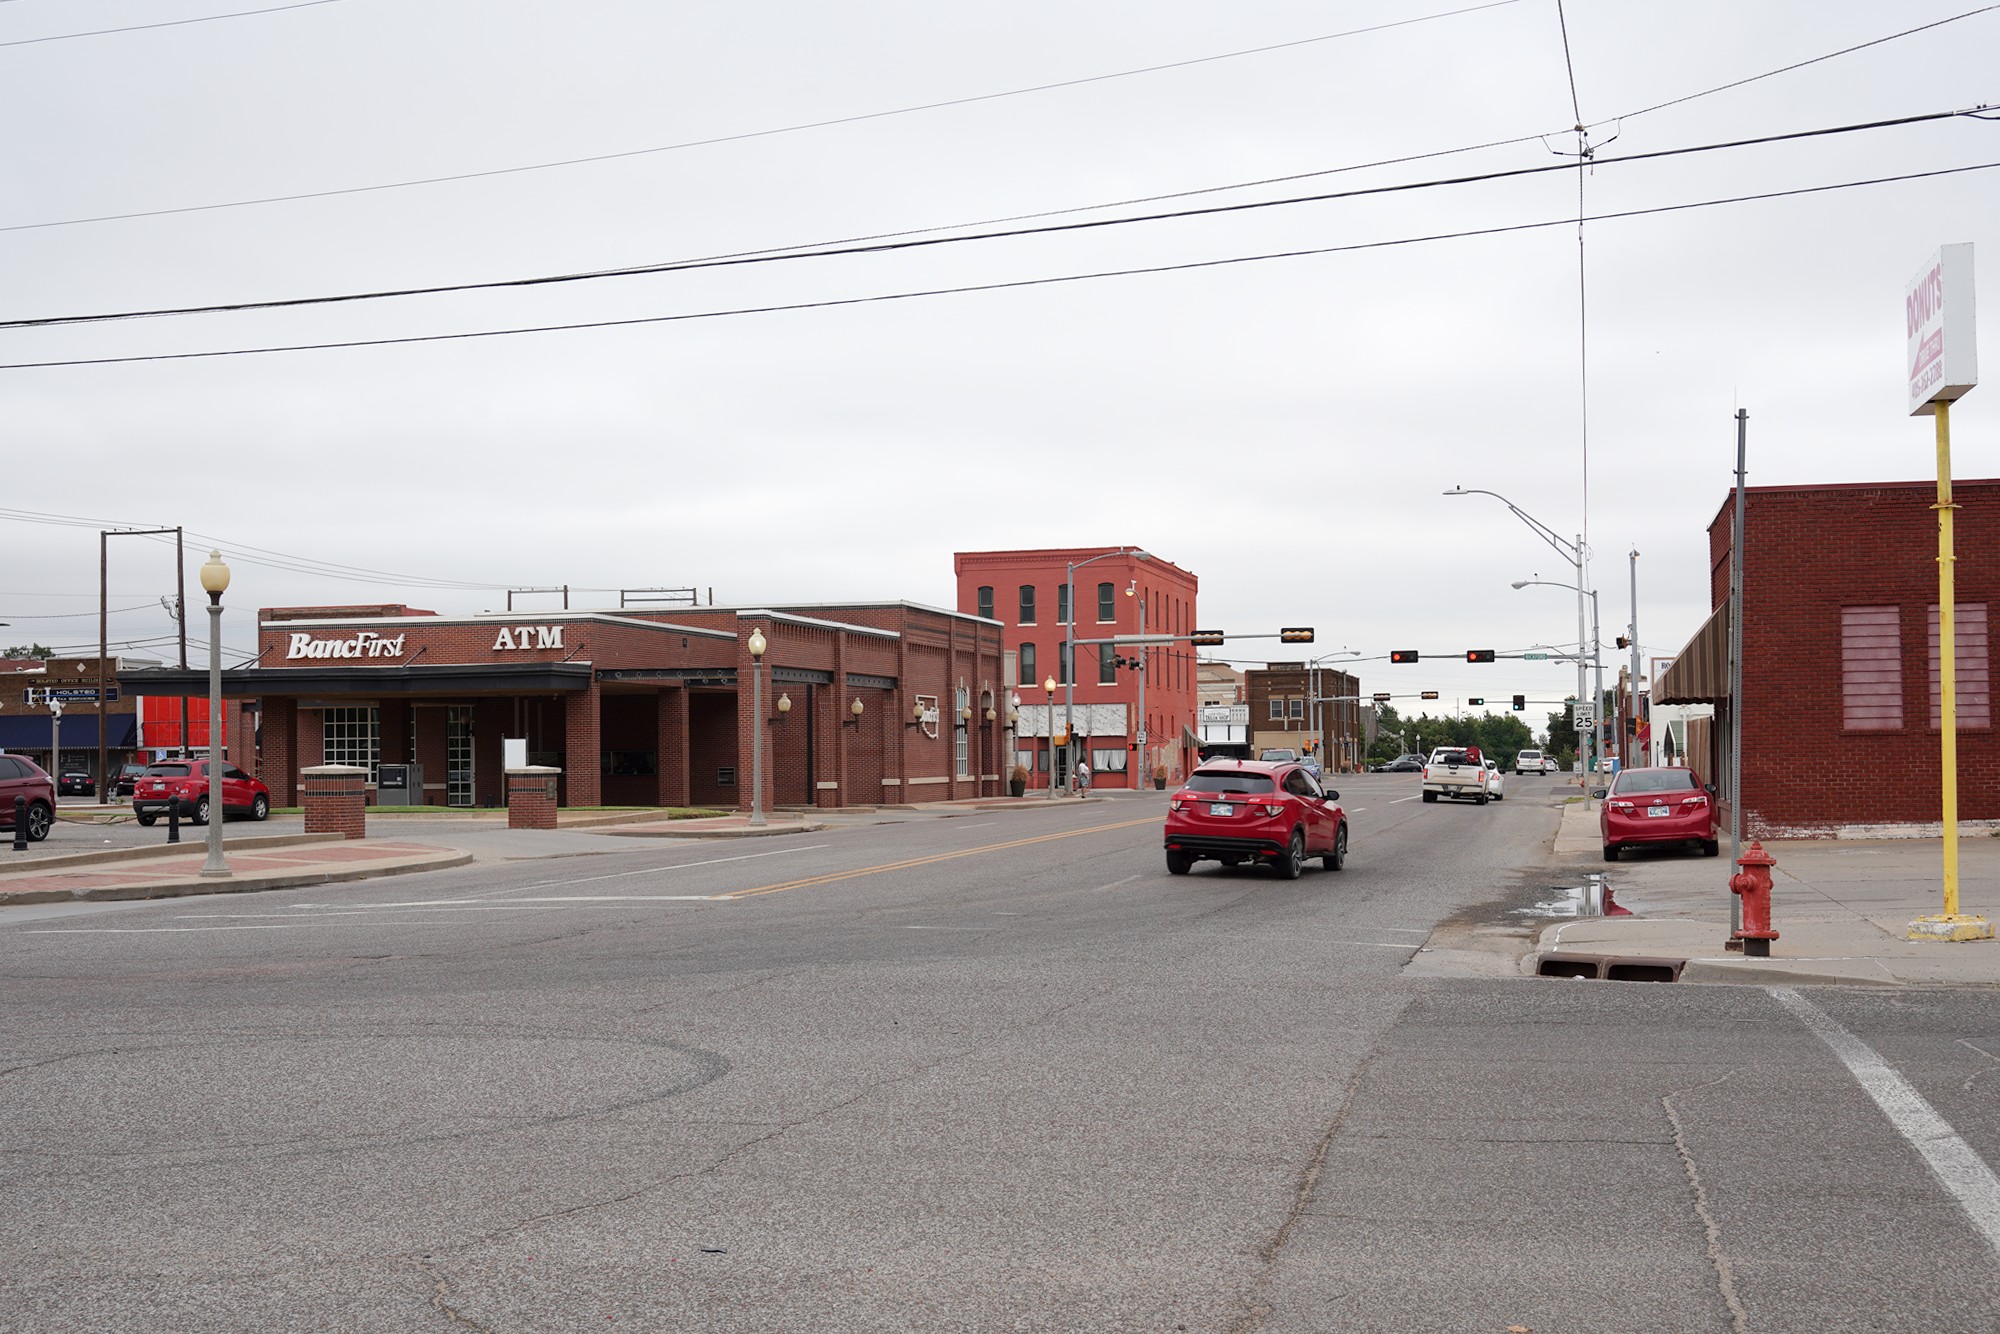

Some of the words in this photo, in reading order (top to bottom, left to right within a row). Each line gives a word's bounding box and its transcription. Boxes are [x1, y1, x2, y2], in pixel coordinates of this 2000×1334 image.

[1906, 262, 1943, 339] DONUTS
[286, 632, 406, 660] BancFirst
[492, 625, 565, 651] ATM
[1575, 717, 1593, 728] 25
